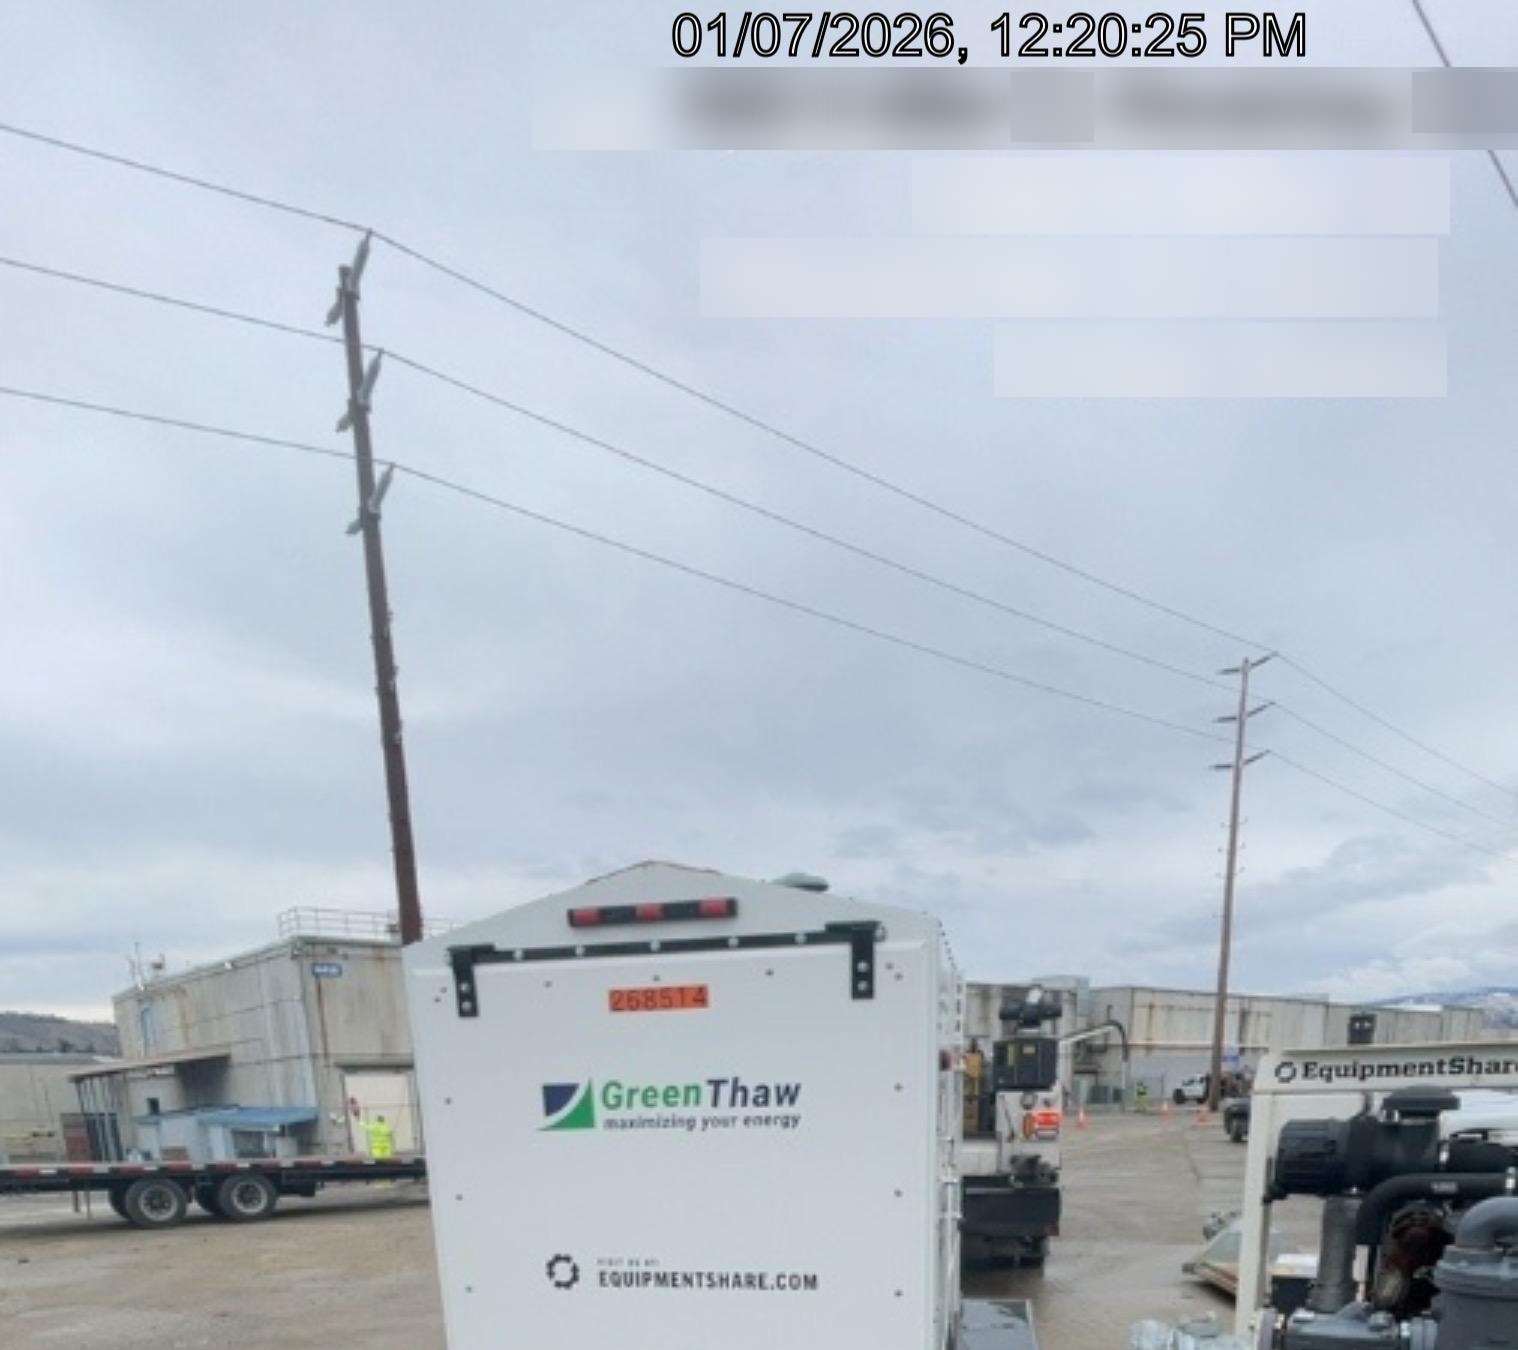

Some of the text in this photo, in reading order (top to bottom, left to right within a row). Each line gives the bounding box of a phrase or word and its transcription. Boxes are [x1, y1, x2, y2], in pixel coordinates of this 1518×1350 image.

[608, 984, 708, 1012] 268514
[604, 1112, 801, 1132] maximizing your energy
[598, 1271, 818, 1291] EQUIPMENTSHARE.COM
